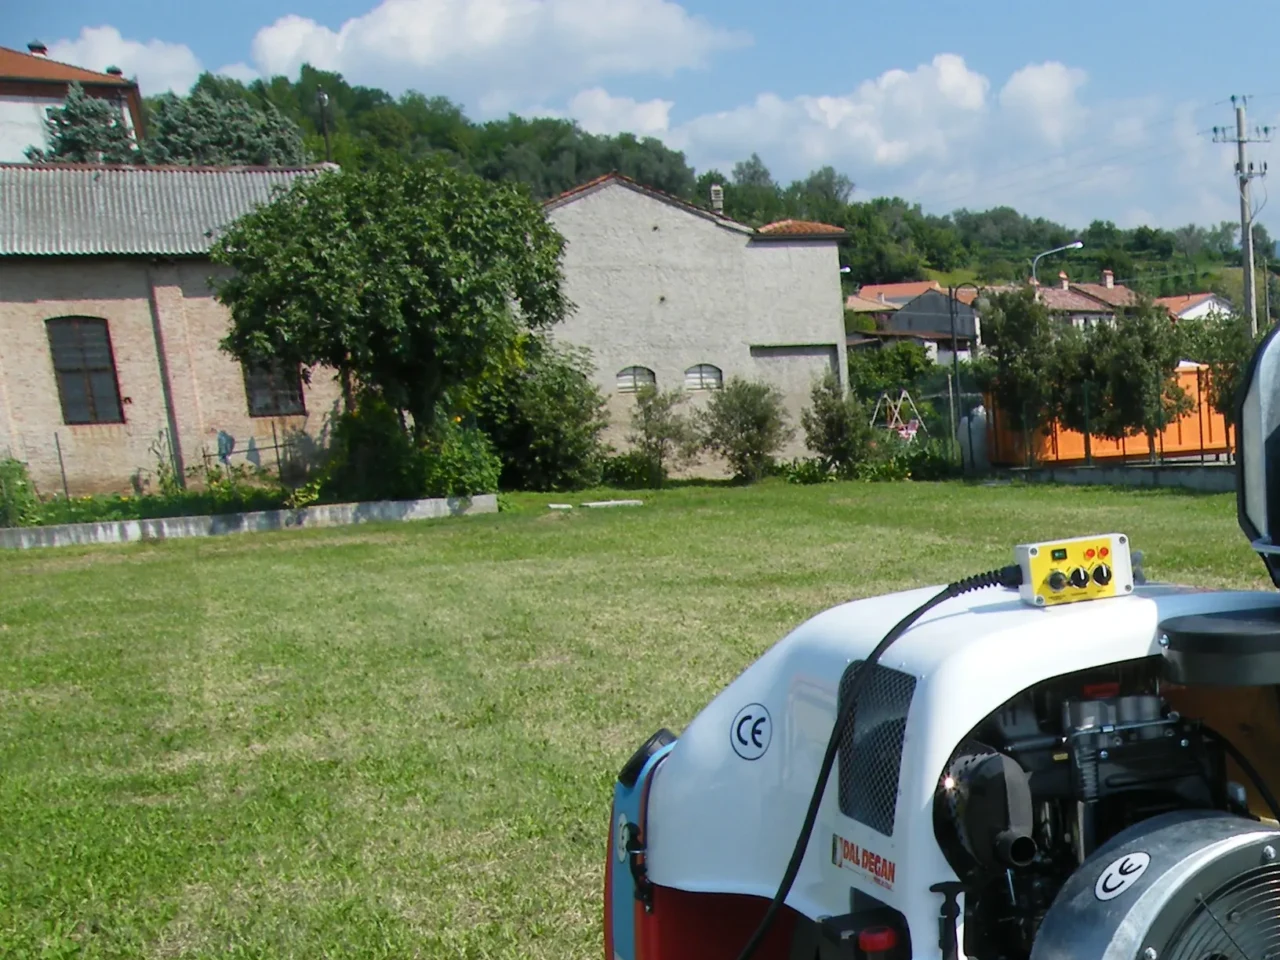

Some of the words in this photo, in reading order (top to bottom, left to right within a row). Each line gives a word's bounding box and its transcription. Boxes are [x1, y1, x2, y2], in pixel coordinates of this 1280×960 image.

[737, 715, 766, 749] CE
[843, 839, 860, 866] DAL
[862, 848, 896, 884] DEGAN
[1102, 857, 1143, 893] CE
